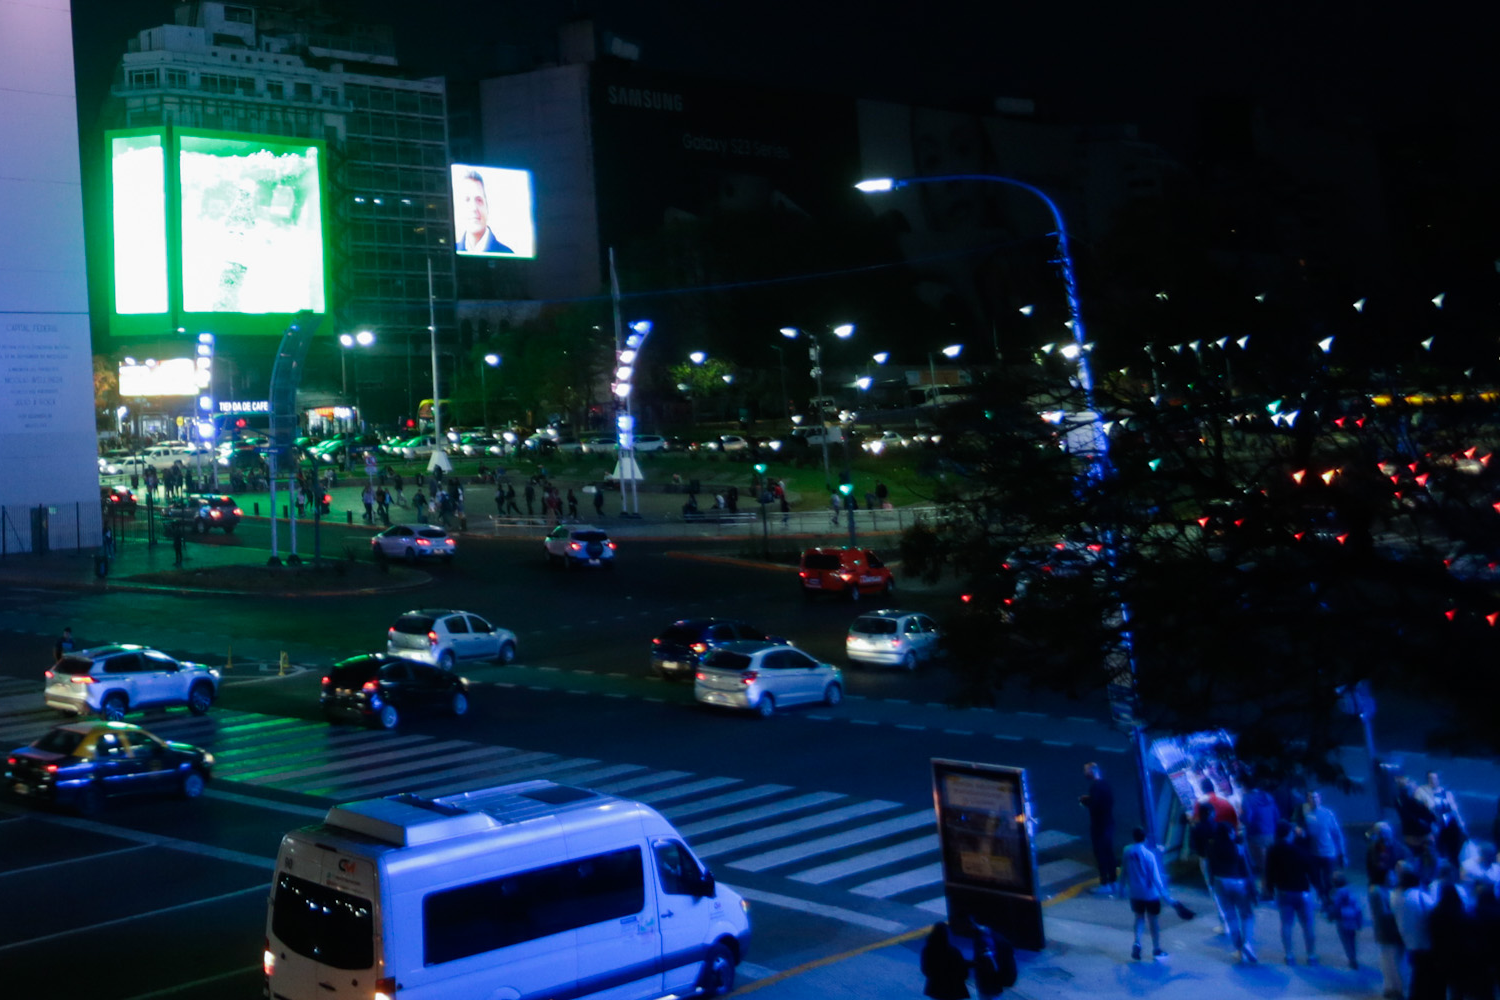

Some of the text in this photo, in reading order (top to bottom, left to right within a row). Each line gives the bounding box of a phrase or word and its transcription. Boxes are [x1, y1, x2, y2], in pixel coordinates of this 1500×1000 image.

[607, 85, 684, 112] SAMSUNG
[682, 133, 790, 159] Galaxy S23 Series
[242, 401, 252, 411] DE
[252, 401, 269, 411] CAFE
